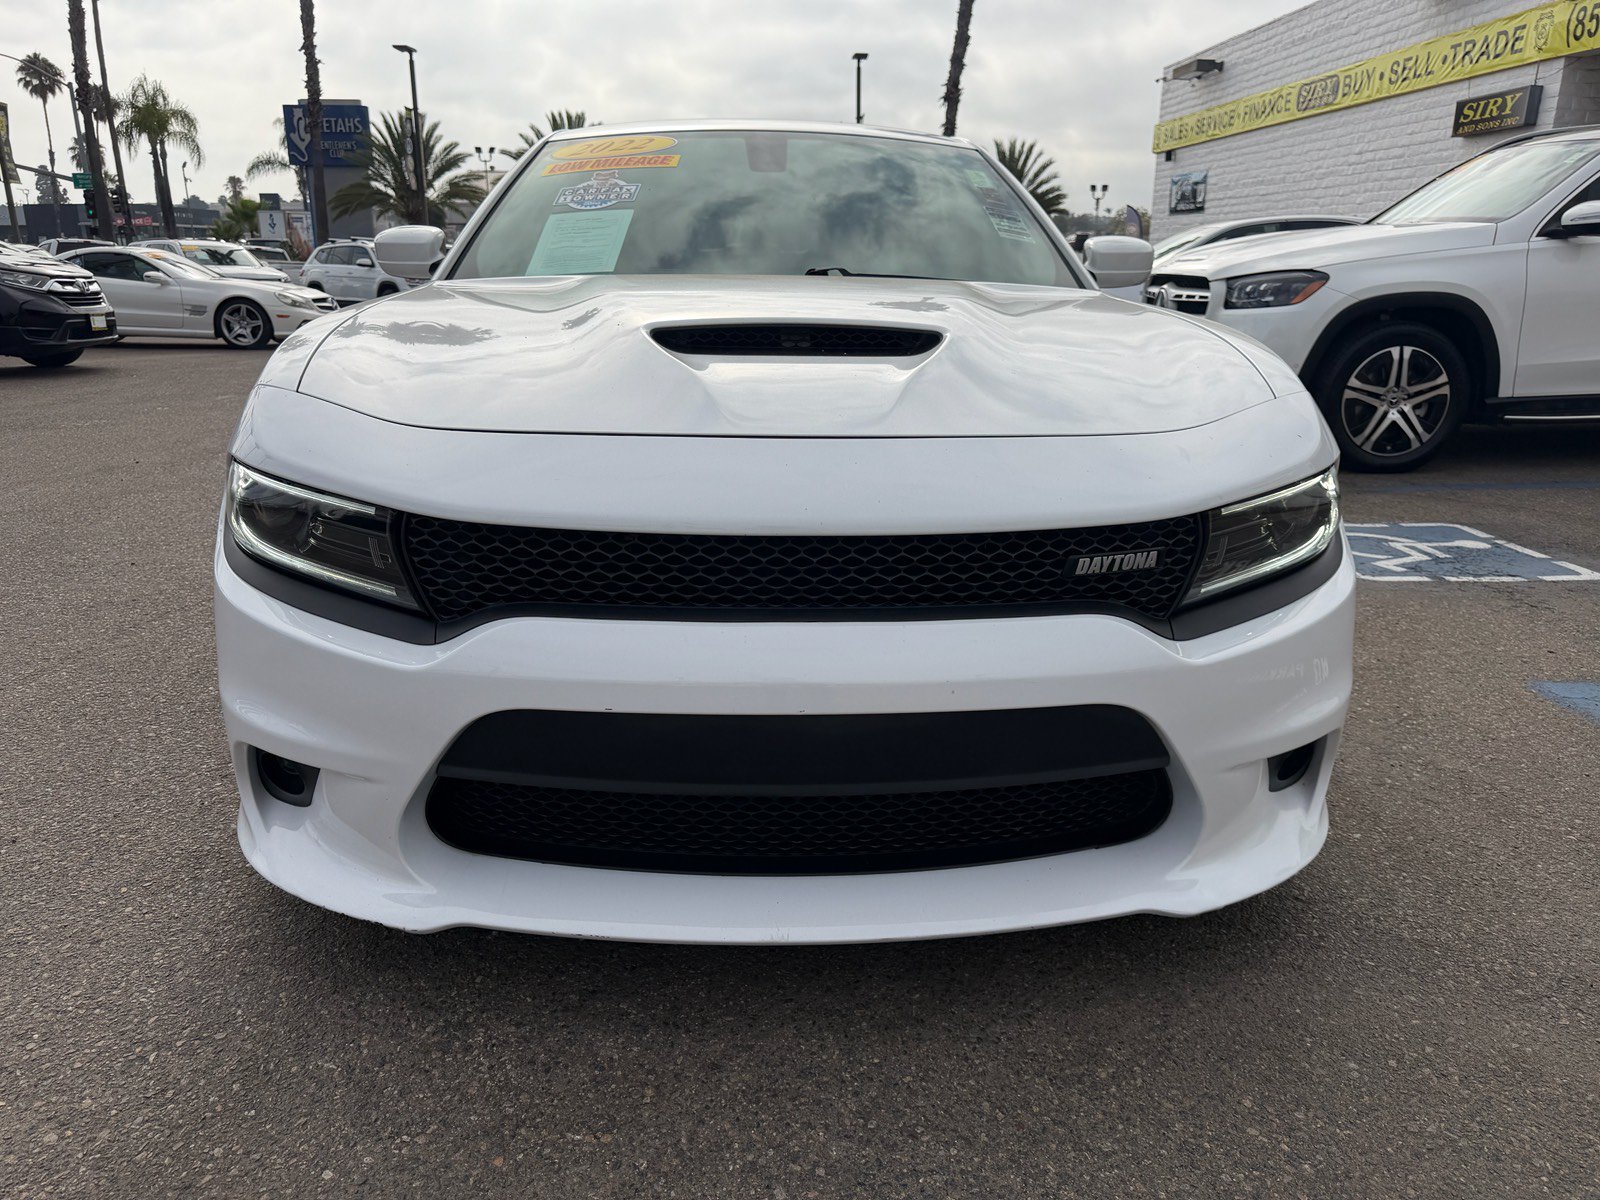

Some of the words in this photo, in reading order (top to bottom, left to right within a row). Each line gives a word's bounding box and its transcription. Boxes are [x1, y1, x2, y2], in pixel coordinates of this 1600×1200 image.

[1341, 66, 1376, 97] BUY
[1388, 51, 1435, 85] SELL
[1450, 24, 1528, 70] TRADE
[1459, 92, 1523, 123] SIRY
[1163, 124, 1190, 144] SALES
[1195, 109, 1236, 136] SERVICE
[1242, 92, 1293, 123] FINANCE
[1456, 125, 1476, 135] AND
[1476, 120, 1501, 131] SONS
[320, 141, 357, 150] ENTLEMEN'S
[567, 138, 655, 157] 2022
[548, 160, 590, 174] LOW
[590, 155, 673, 169] MILEAGE
[565, 186, 635, 196] CARFAX
[1075, 551, 1158, 575] DAYTONA
